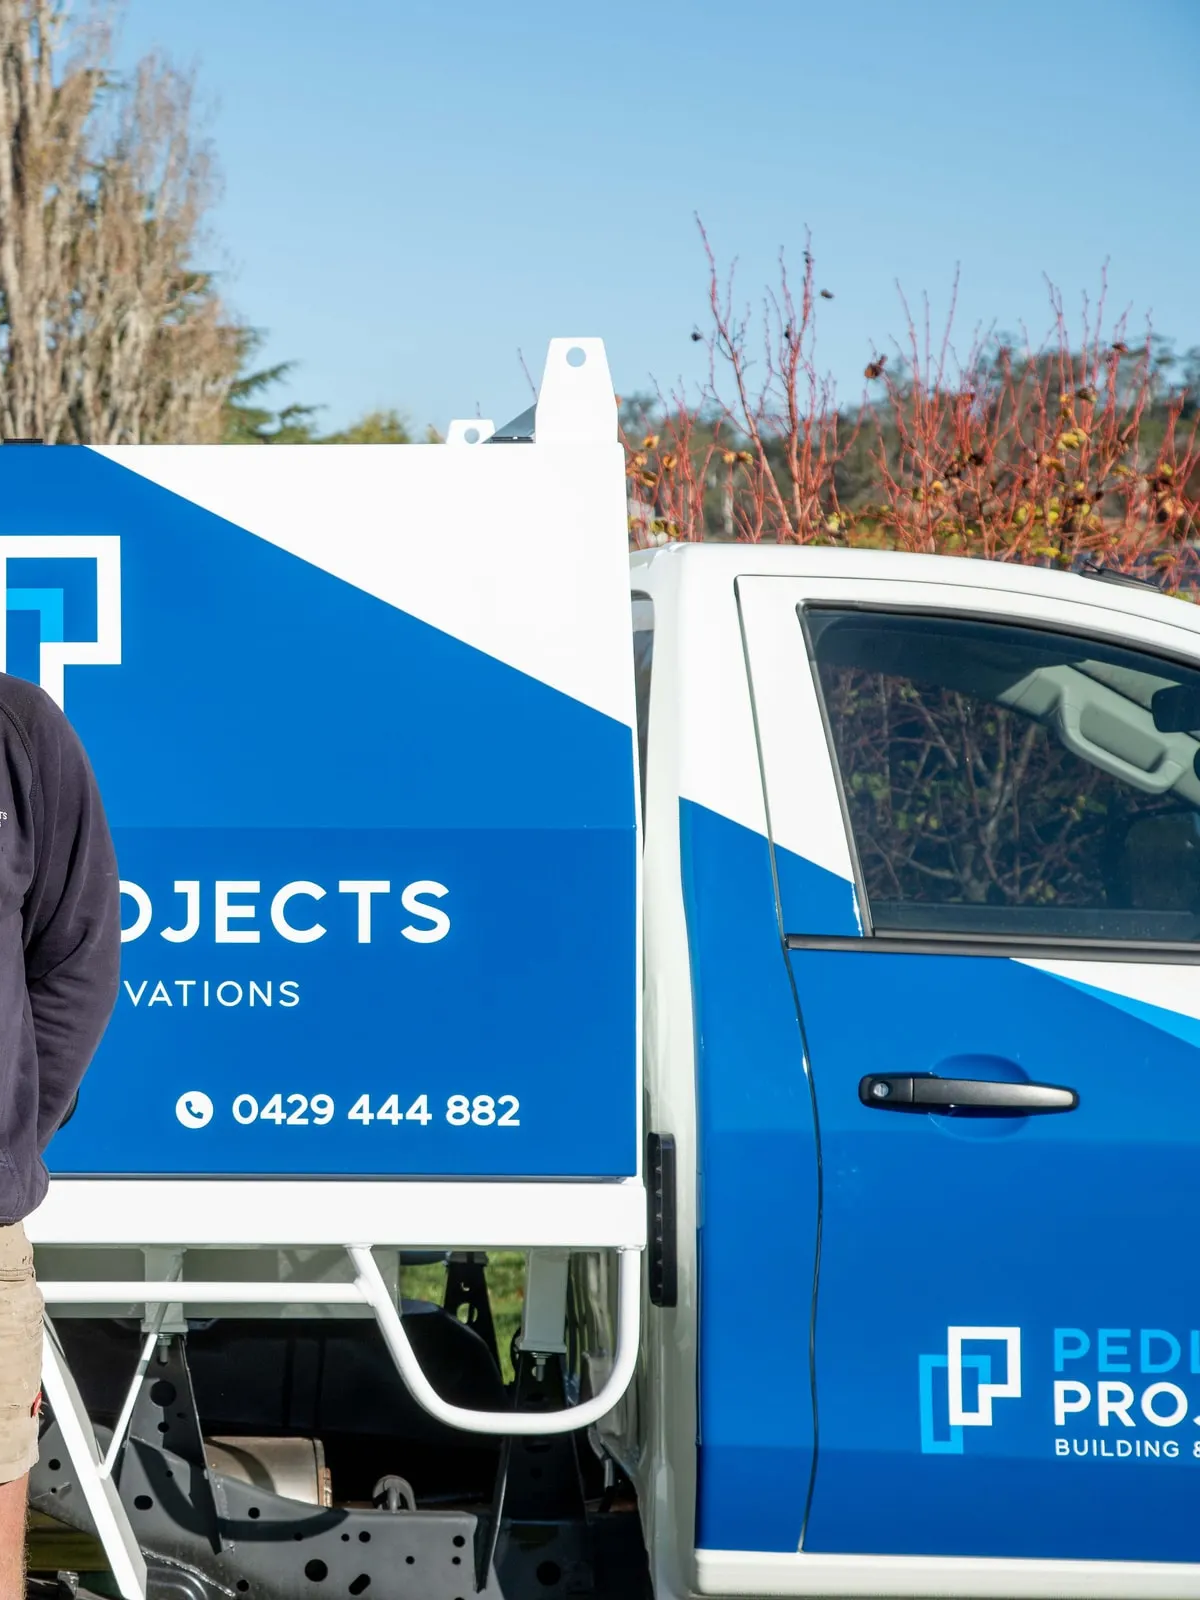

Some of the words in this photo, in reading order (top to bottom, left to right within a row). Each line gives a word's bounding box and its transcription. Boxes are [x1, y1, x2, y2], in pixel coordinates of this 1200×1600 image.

[123, 980, 300, 1007] VATIONS
[232, 1093, 335, 1126] 0429
[347, 1093, 433, 1126] 444
[445, 1094, 520, 1127] 882
[1053, 1380, 1200, 1428] PRO
[1055, 1438, 1180, 1458] BUILDING
